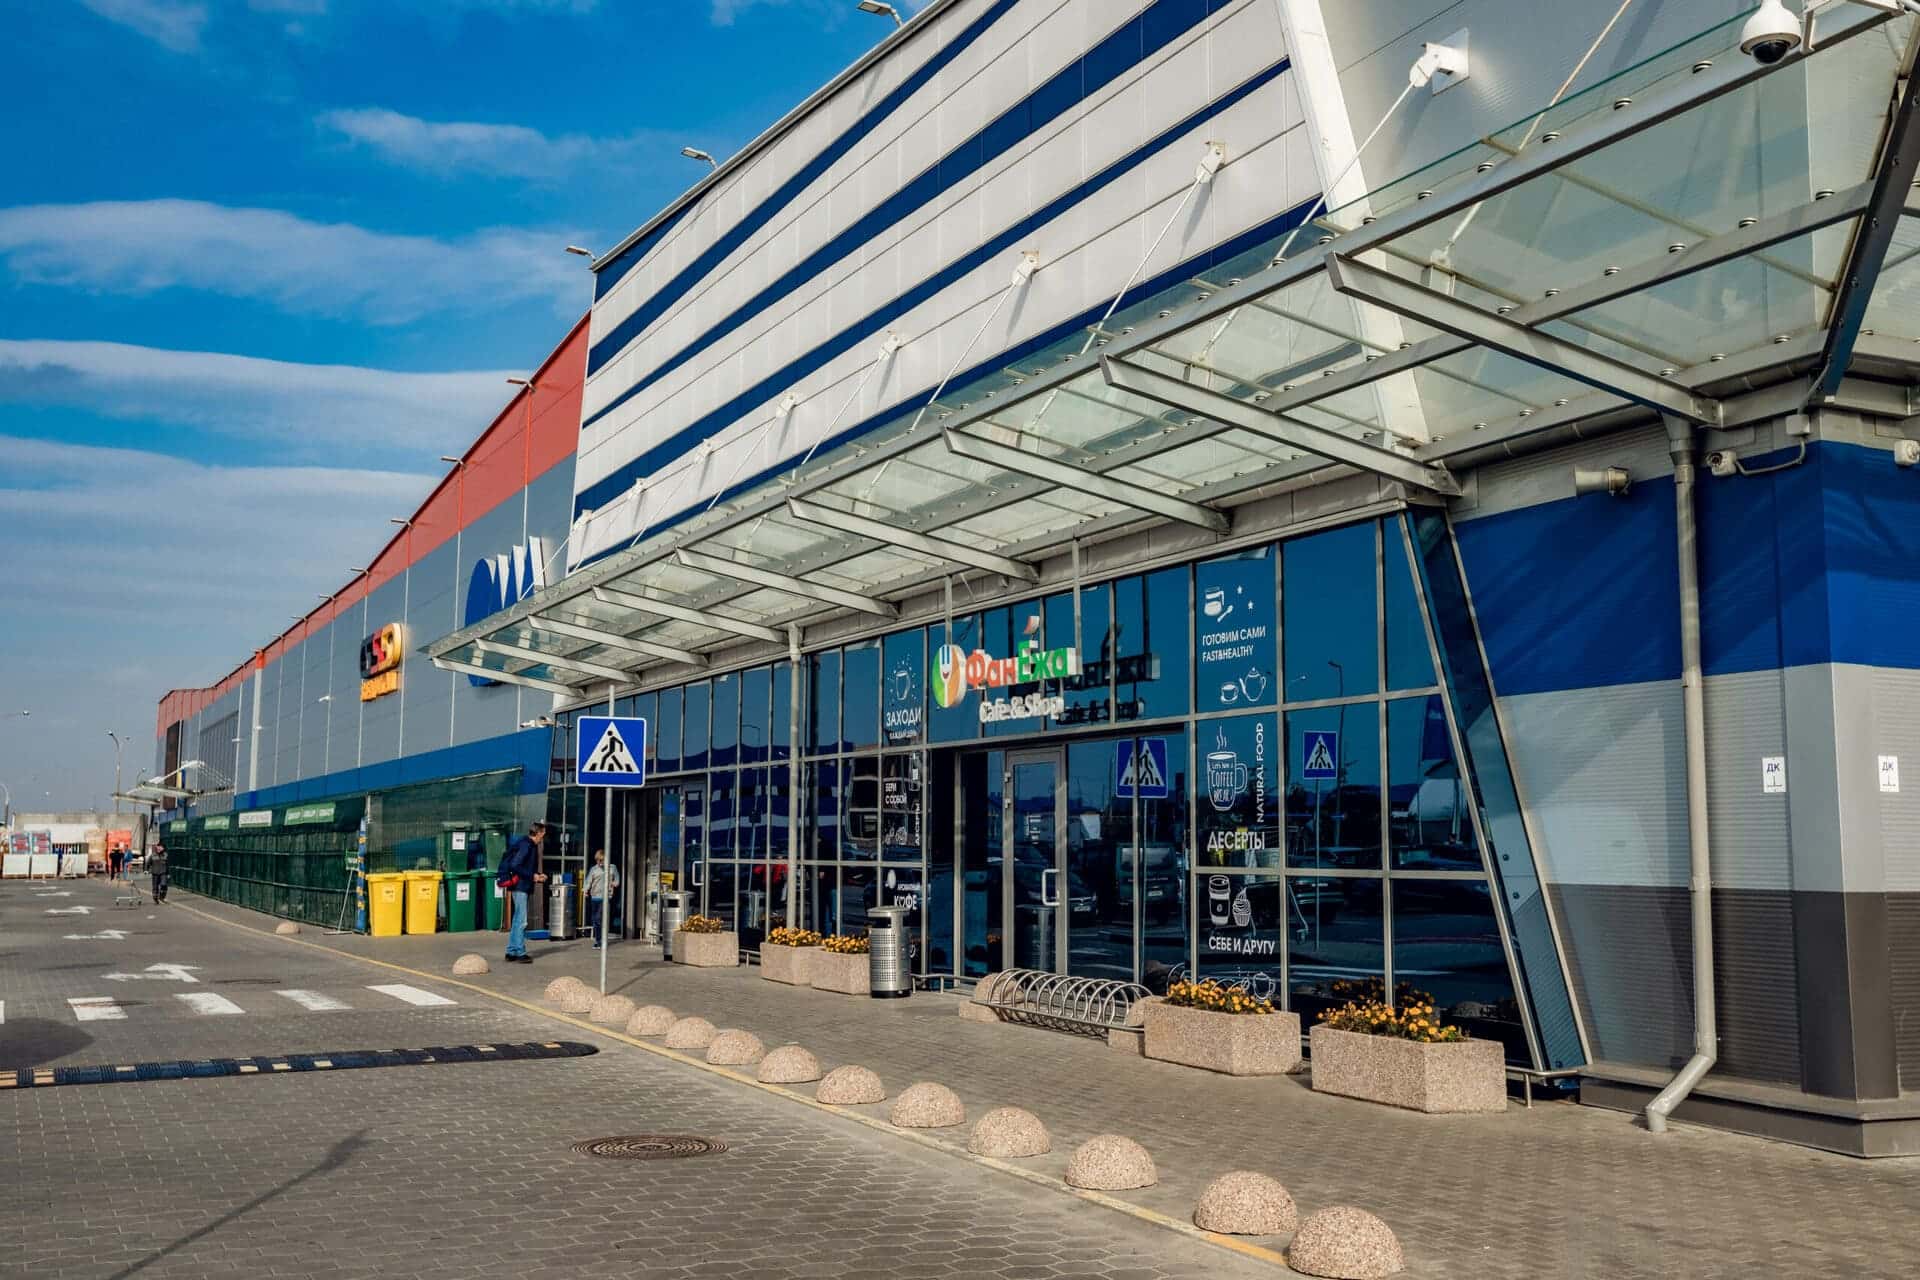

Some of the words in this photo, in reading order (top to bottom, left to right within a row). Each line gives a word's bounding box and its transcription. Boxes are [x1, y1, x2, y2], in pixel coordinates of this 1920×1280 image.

[1202, 630, 1239, 647] ГОТОВИМ
[1240, 625, 1266, 641] САМИ
[886, 706, 922, 727] ЗАХОДИ
[1255, 722, 1265, 761] FOOD
[1766, 762, 1781, 773] ДК
[1255, 764, 1265, 823] NATURAL
[1206, 831, 1265, 852] ДЕСЕРТЫ
[1208, 936, 1232, 952] СЕБЕ
[1233, 938, 1241, 953] И
[1242, 940, 1275, 956] ДРУГУ
